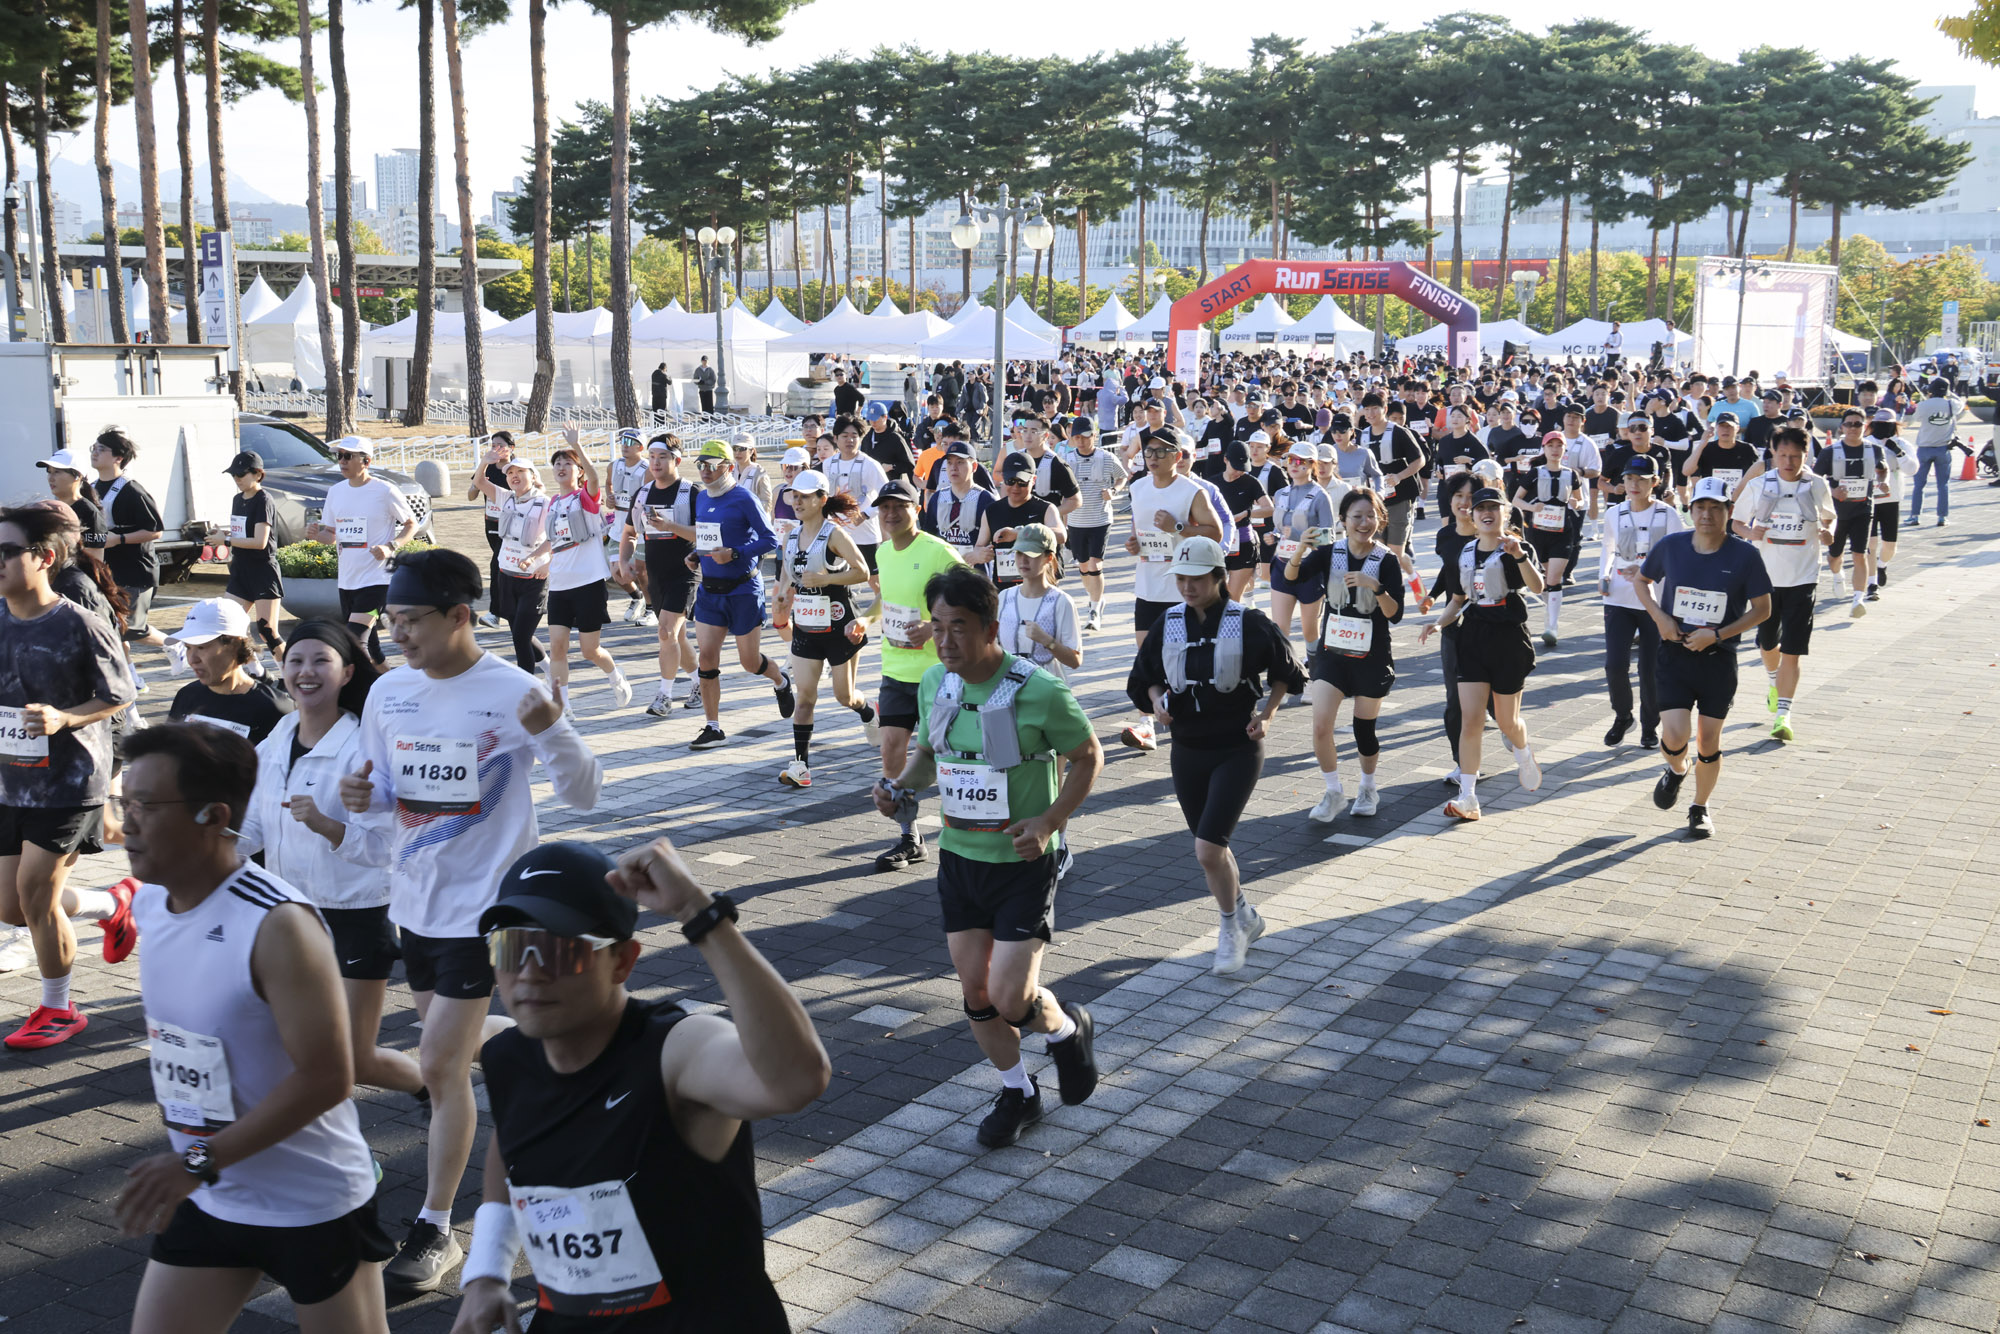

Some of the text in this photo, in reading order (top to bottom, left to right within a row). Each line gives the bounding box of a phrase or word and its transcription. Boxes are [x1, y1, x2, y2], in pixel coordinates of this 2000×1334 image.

[207, 238, 218, 262] E
[1275, 267, 1320, 289] Run
[1200, 274, 1252, 313] START
[1408, 275, 1462, 316] FINISH
[1946, 303, 1953, 312] F
[1417, 345, 1448, 353] PRESS
[1562, 345, 1604, 355] MC 대
[939, 528, 970, 538] QATAR
[1179, 548, 1190, 560] H
[802, 608, 825, 616] 2419
[1691, 601, 1718, 613] 1511
[1338, 629, 1365, 640] 2011
[396, 740, 414, 751] Run
[402, 764, 467, 781] M 1830
[946, 787, 997, 801] M 1405
[166, 1062, 212, 1091] 1091
[589, 1188, 621, 1201] 10km
[547, 1228, 623, 1260] 1637
